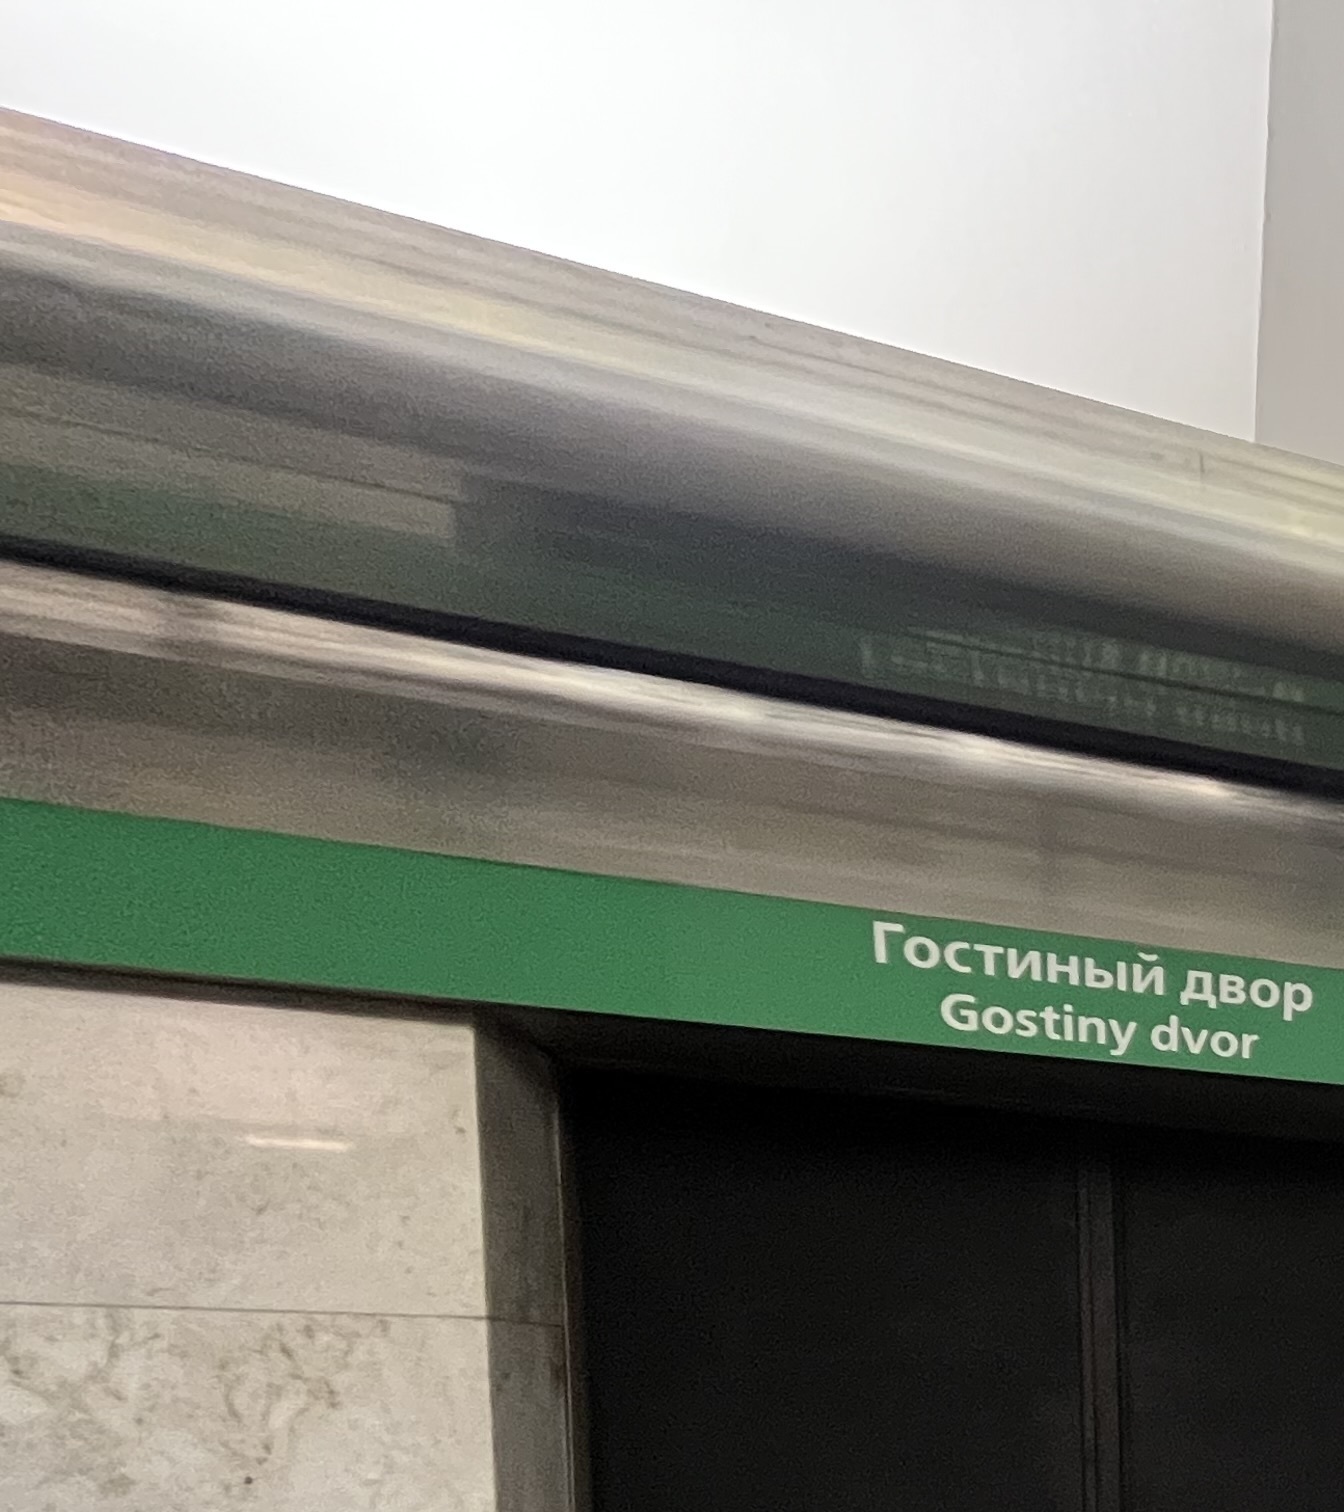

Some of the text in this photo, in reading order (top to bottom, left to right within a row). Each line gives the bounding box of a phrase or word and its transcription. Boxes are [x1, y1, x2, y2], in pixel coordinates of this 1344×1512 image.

[872, 920, 1314, 1021] Гостиный двор
[940, 993, 1260, 1060] Gostiny dvor
